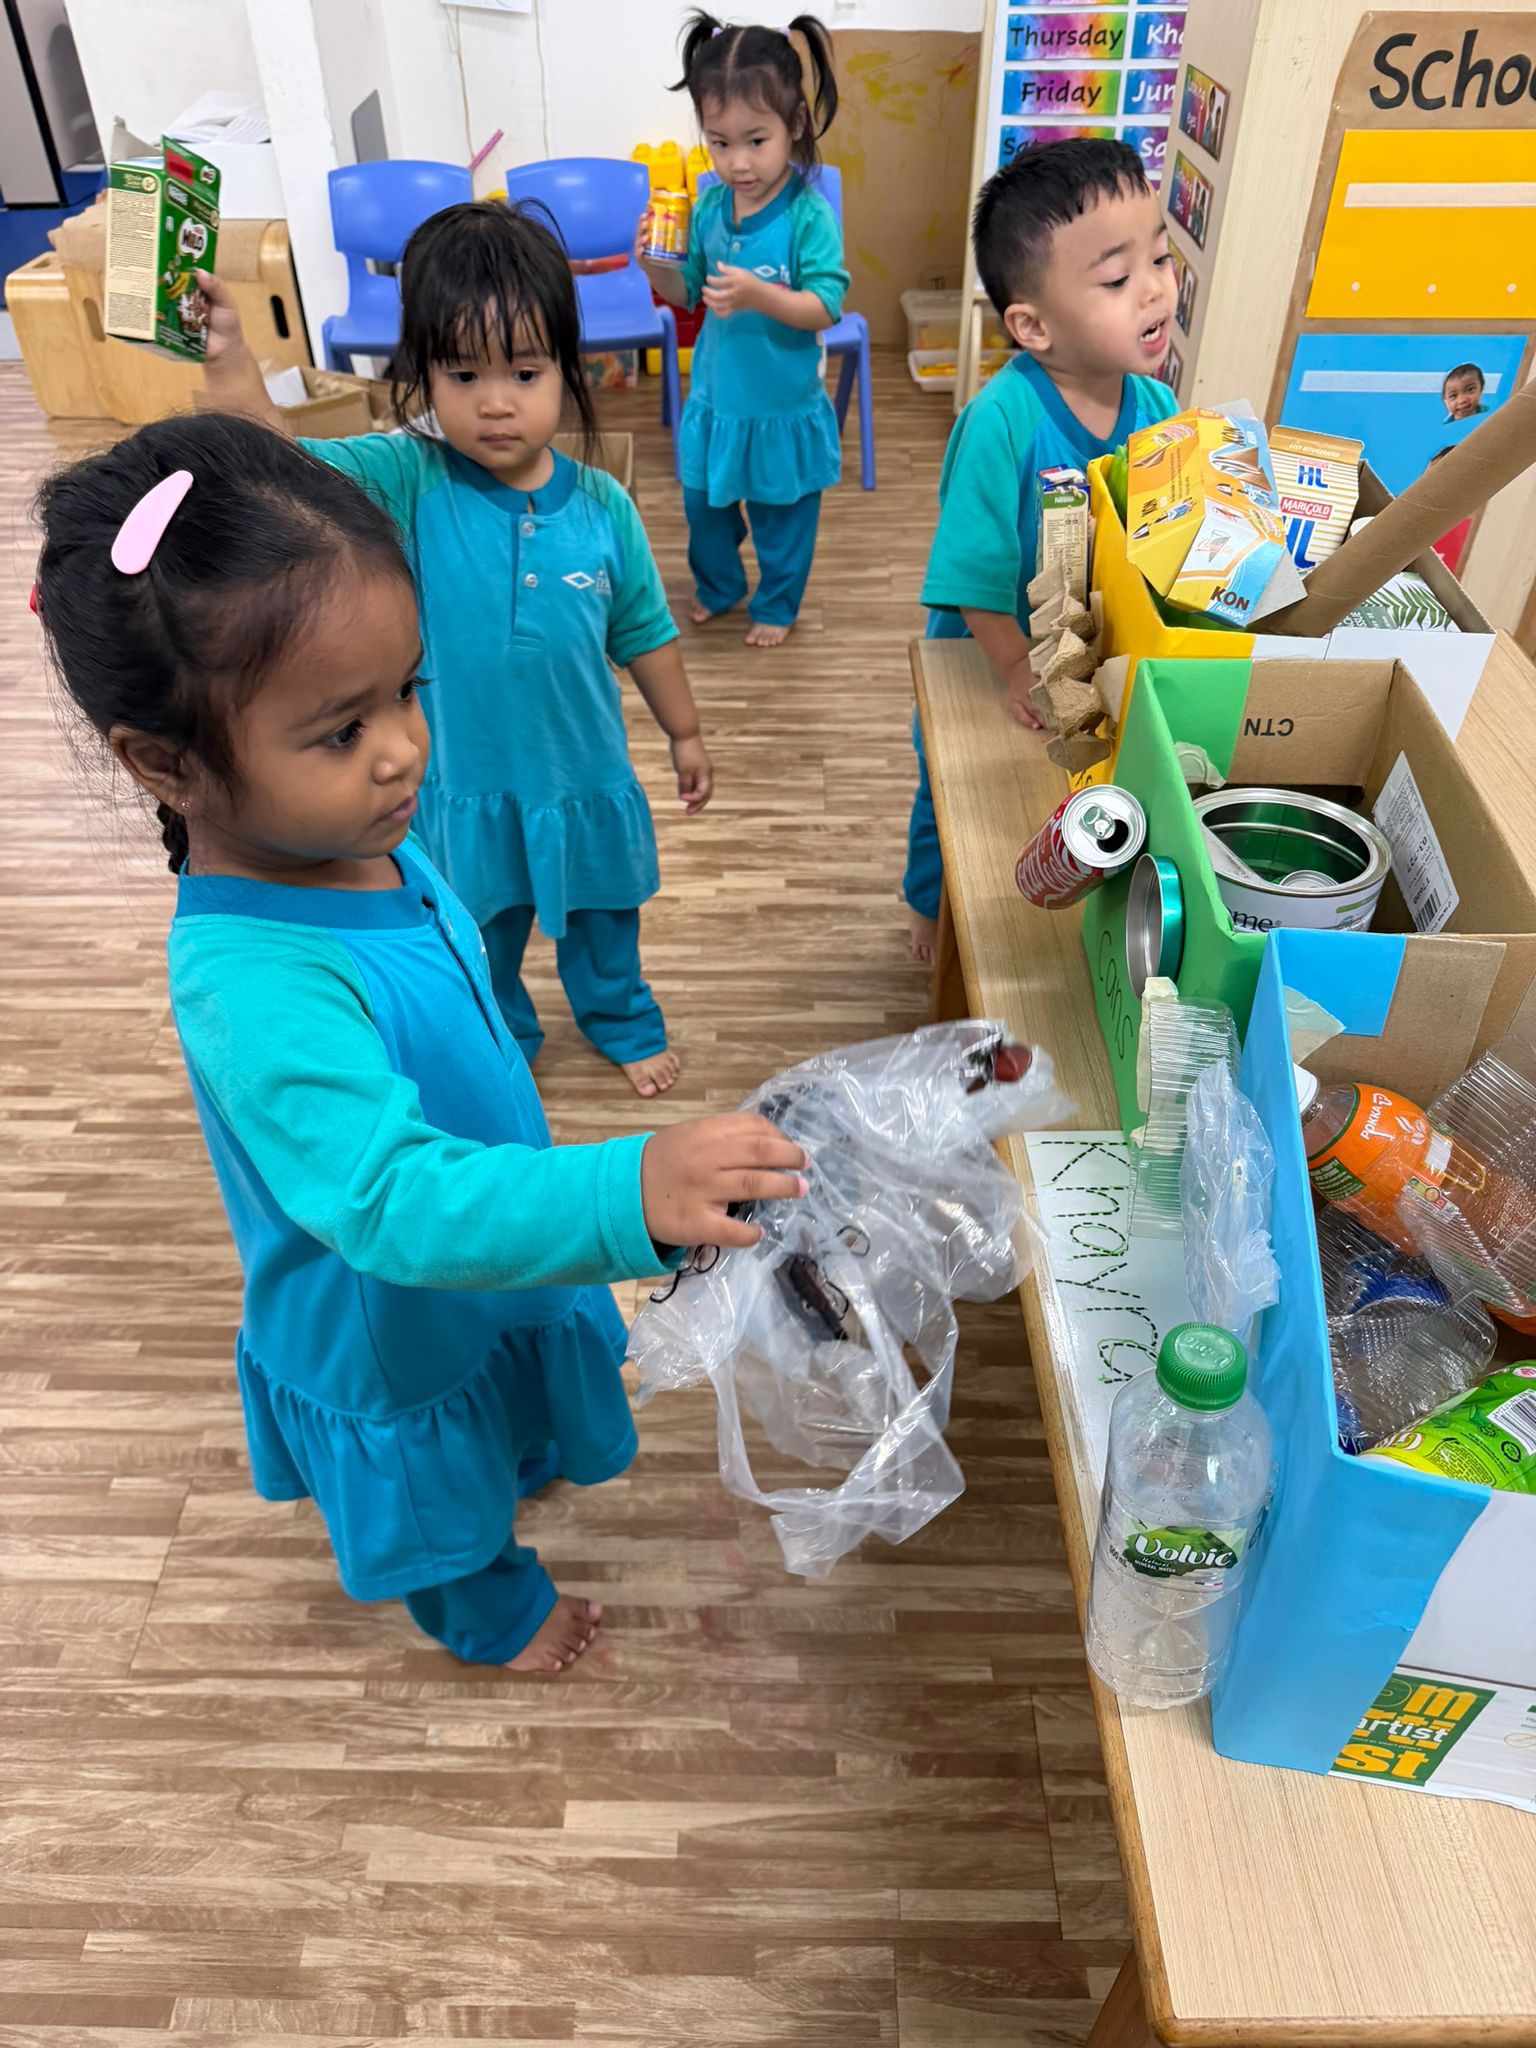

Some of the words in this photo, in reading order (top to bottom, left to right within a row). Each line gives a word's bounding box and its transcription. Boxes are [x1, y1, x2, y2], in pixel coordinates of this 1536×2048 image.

[1010, 24, 1123, 50] Thursday
[1369, 29, 1536, 111] Scho
[1021, 80, 1102, 108] Friday
[1298, 465, 1328, 488] HL
[1282, 499, 1331, 516] MARIGOLD
[1210, 586, 1251, 611] KON
[1243, 718, 1294, 736] CTN
[1227, 906, 1274, 932] me
[1099, 930, 1133, 1059] Cans
[1360, 1103, 1384, 1141] POKKA
[1134, 1534, 1233, 1566] Volvic
[1142, 1557, 1170, 1567] Natural
